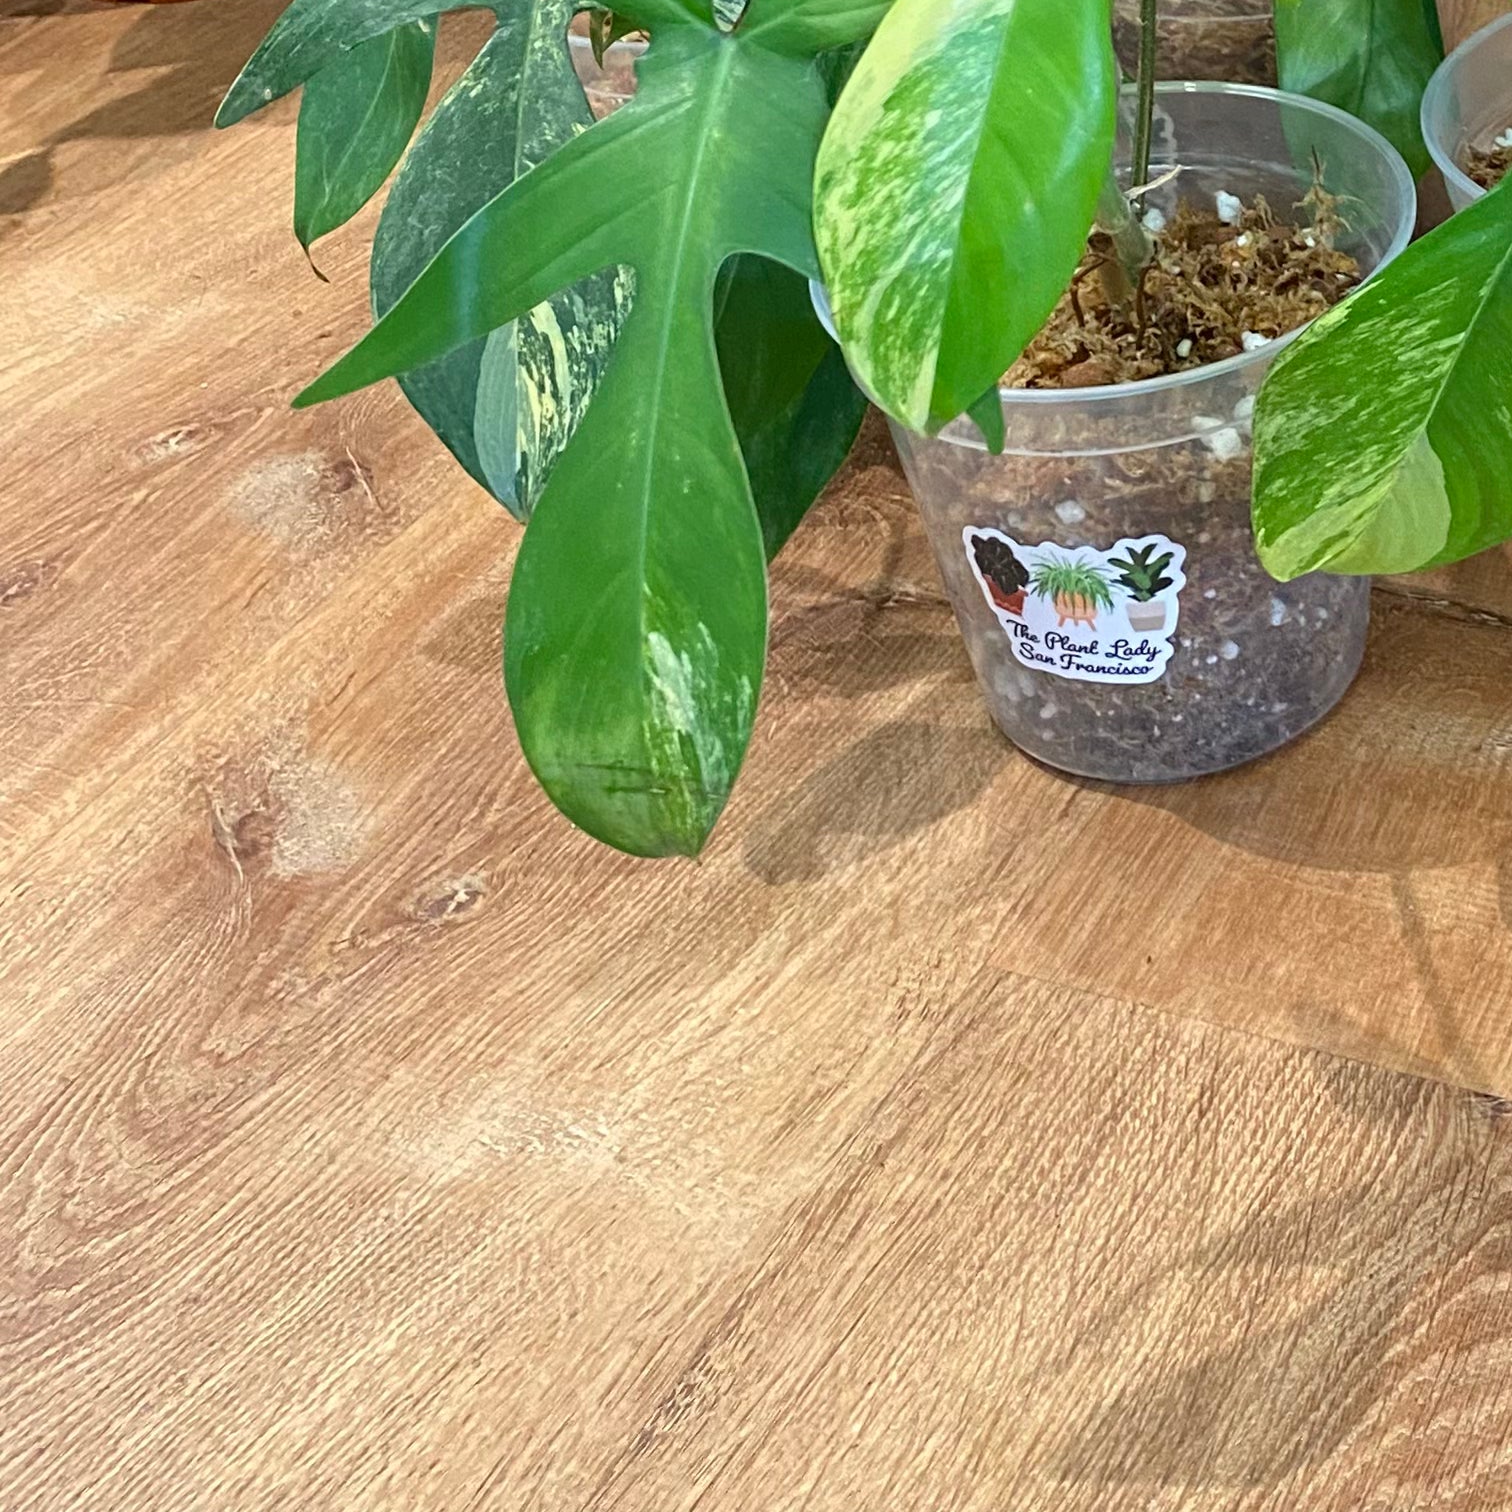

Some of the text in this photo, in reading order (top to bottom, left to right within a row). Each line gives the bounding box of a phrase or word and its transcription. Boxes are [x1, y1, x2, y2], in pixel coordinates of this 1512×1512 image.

[1006, 619, 1162, 662] The Plant Lady
[1018, 642, 1153, 675] San Francisco
